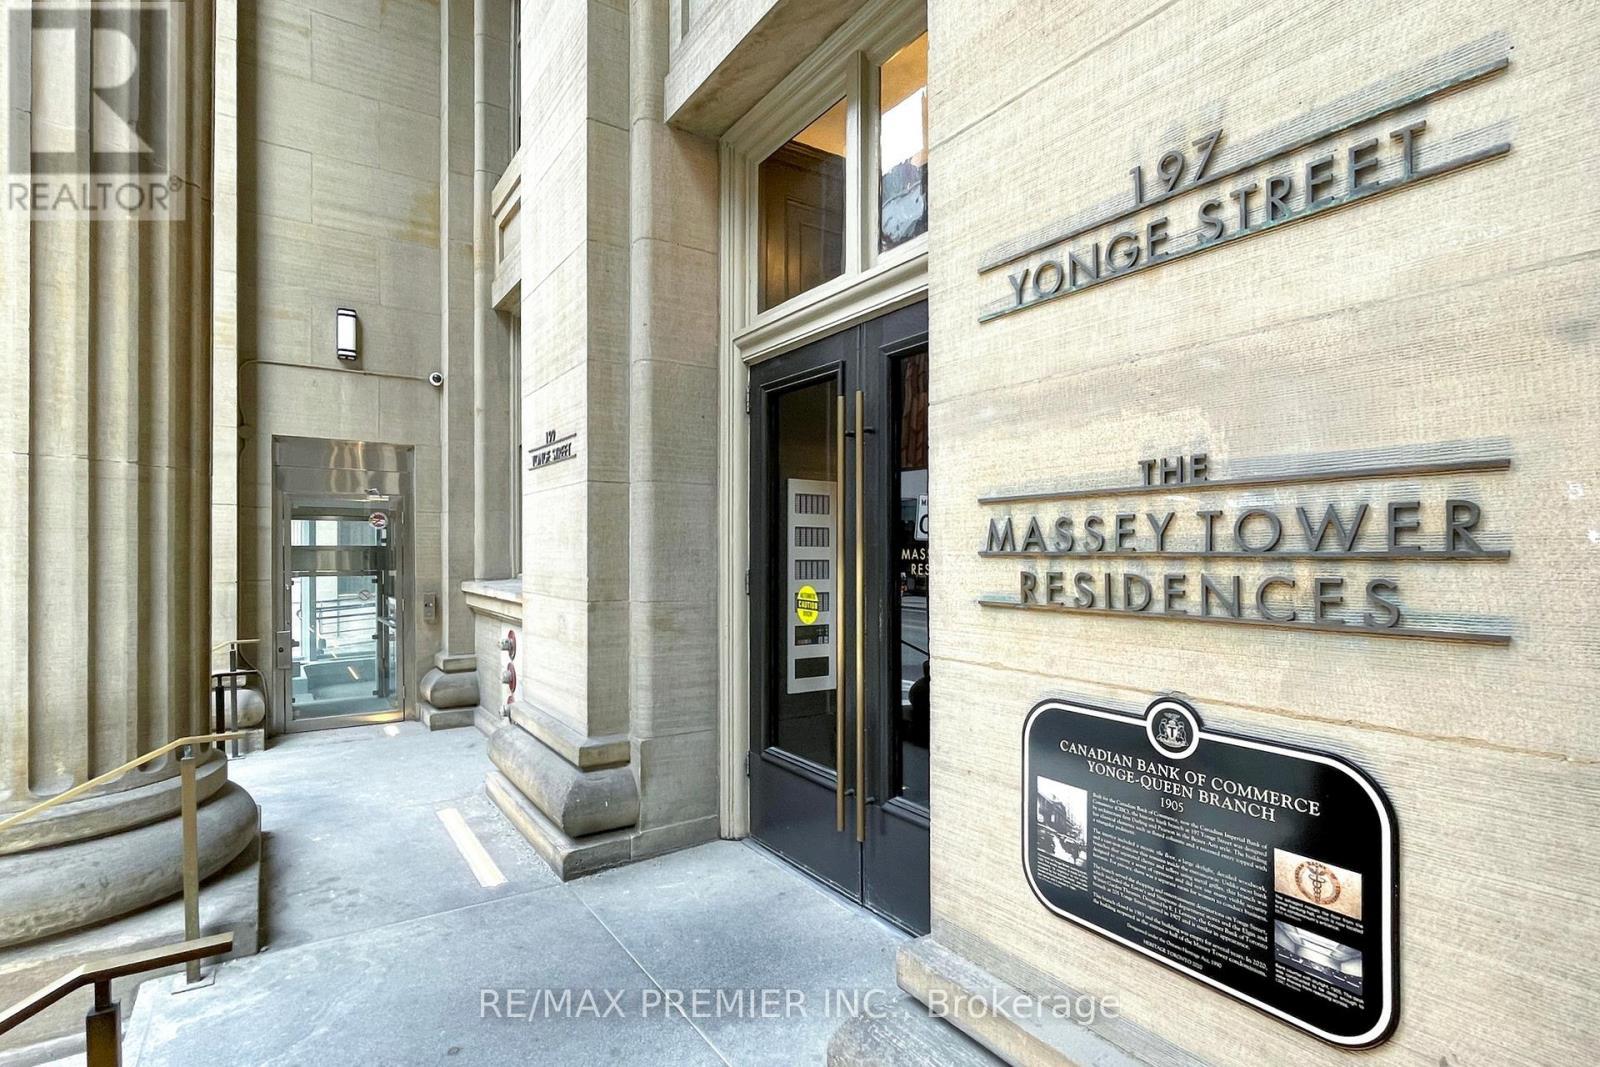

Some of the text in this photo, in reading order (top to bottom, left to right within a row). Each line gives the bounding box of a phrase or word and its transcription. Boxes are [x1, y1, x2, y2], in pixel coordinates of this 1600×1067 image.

[1129, 128, 1223, 205] 197
[1008, 120, 1427, 308] YONGE STREET
[1138, 453, 1208, 487] THE
[901, 548, 929, 560] MAS
[985, 511, 1175, 553] MASSEY
[1197, 499, 1484, 553] TOWER
[1020, 571, 1401, 629] RESIDENCES
[1060, 740, 1321, 818] CANADIAN BANK OF COMMERCE
[1087, 760, 1276, 822] YONGE-QUEEN BRANCH
[1160, 797, 1184, 814] 1905
